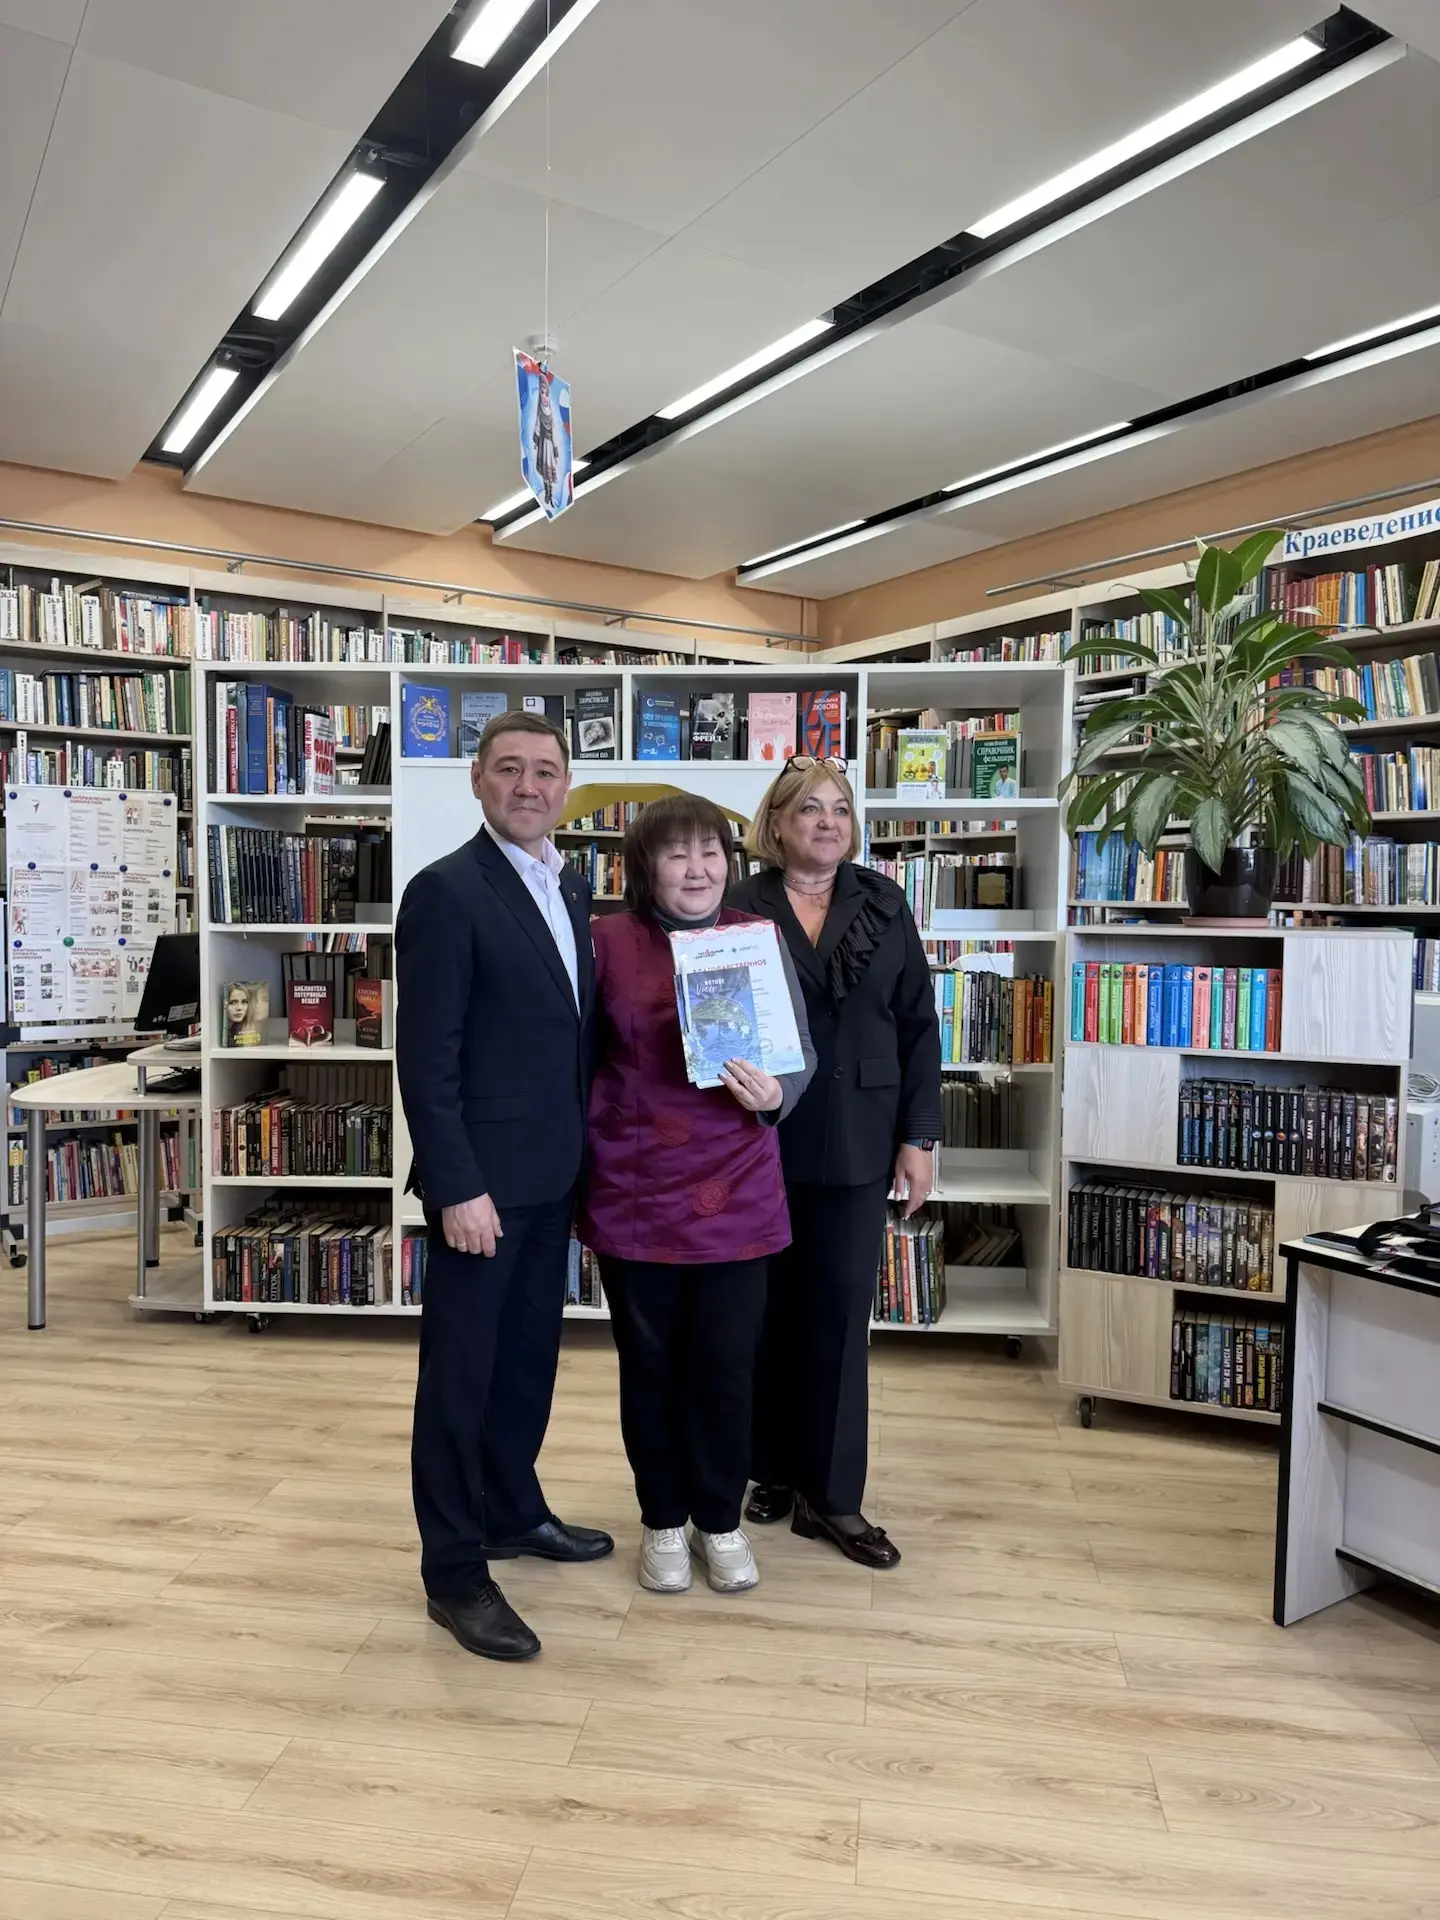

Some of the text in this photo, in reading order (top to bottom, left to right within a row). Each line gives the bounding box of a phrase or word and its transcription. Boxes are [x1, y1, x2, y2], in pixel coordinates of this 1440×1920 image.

[1285, 505, 1440, 557] Краеведение
[314, 738, 334, 756] ФЛАГИ
[976, 746, 1014, 756] СПРАВОЧНИК
[315, 758, 334, 777] МИРА
